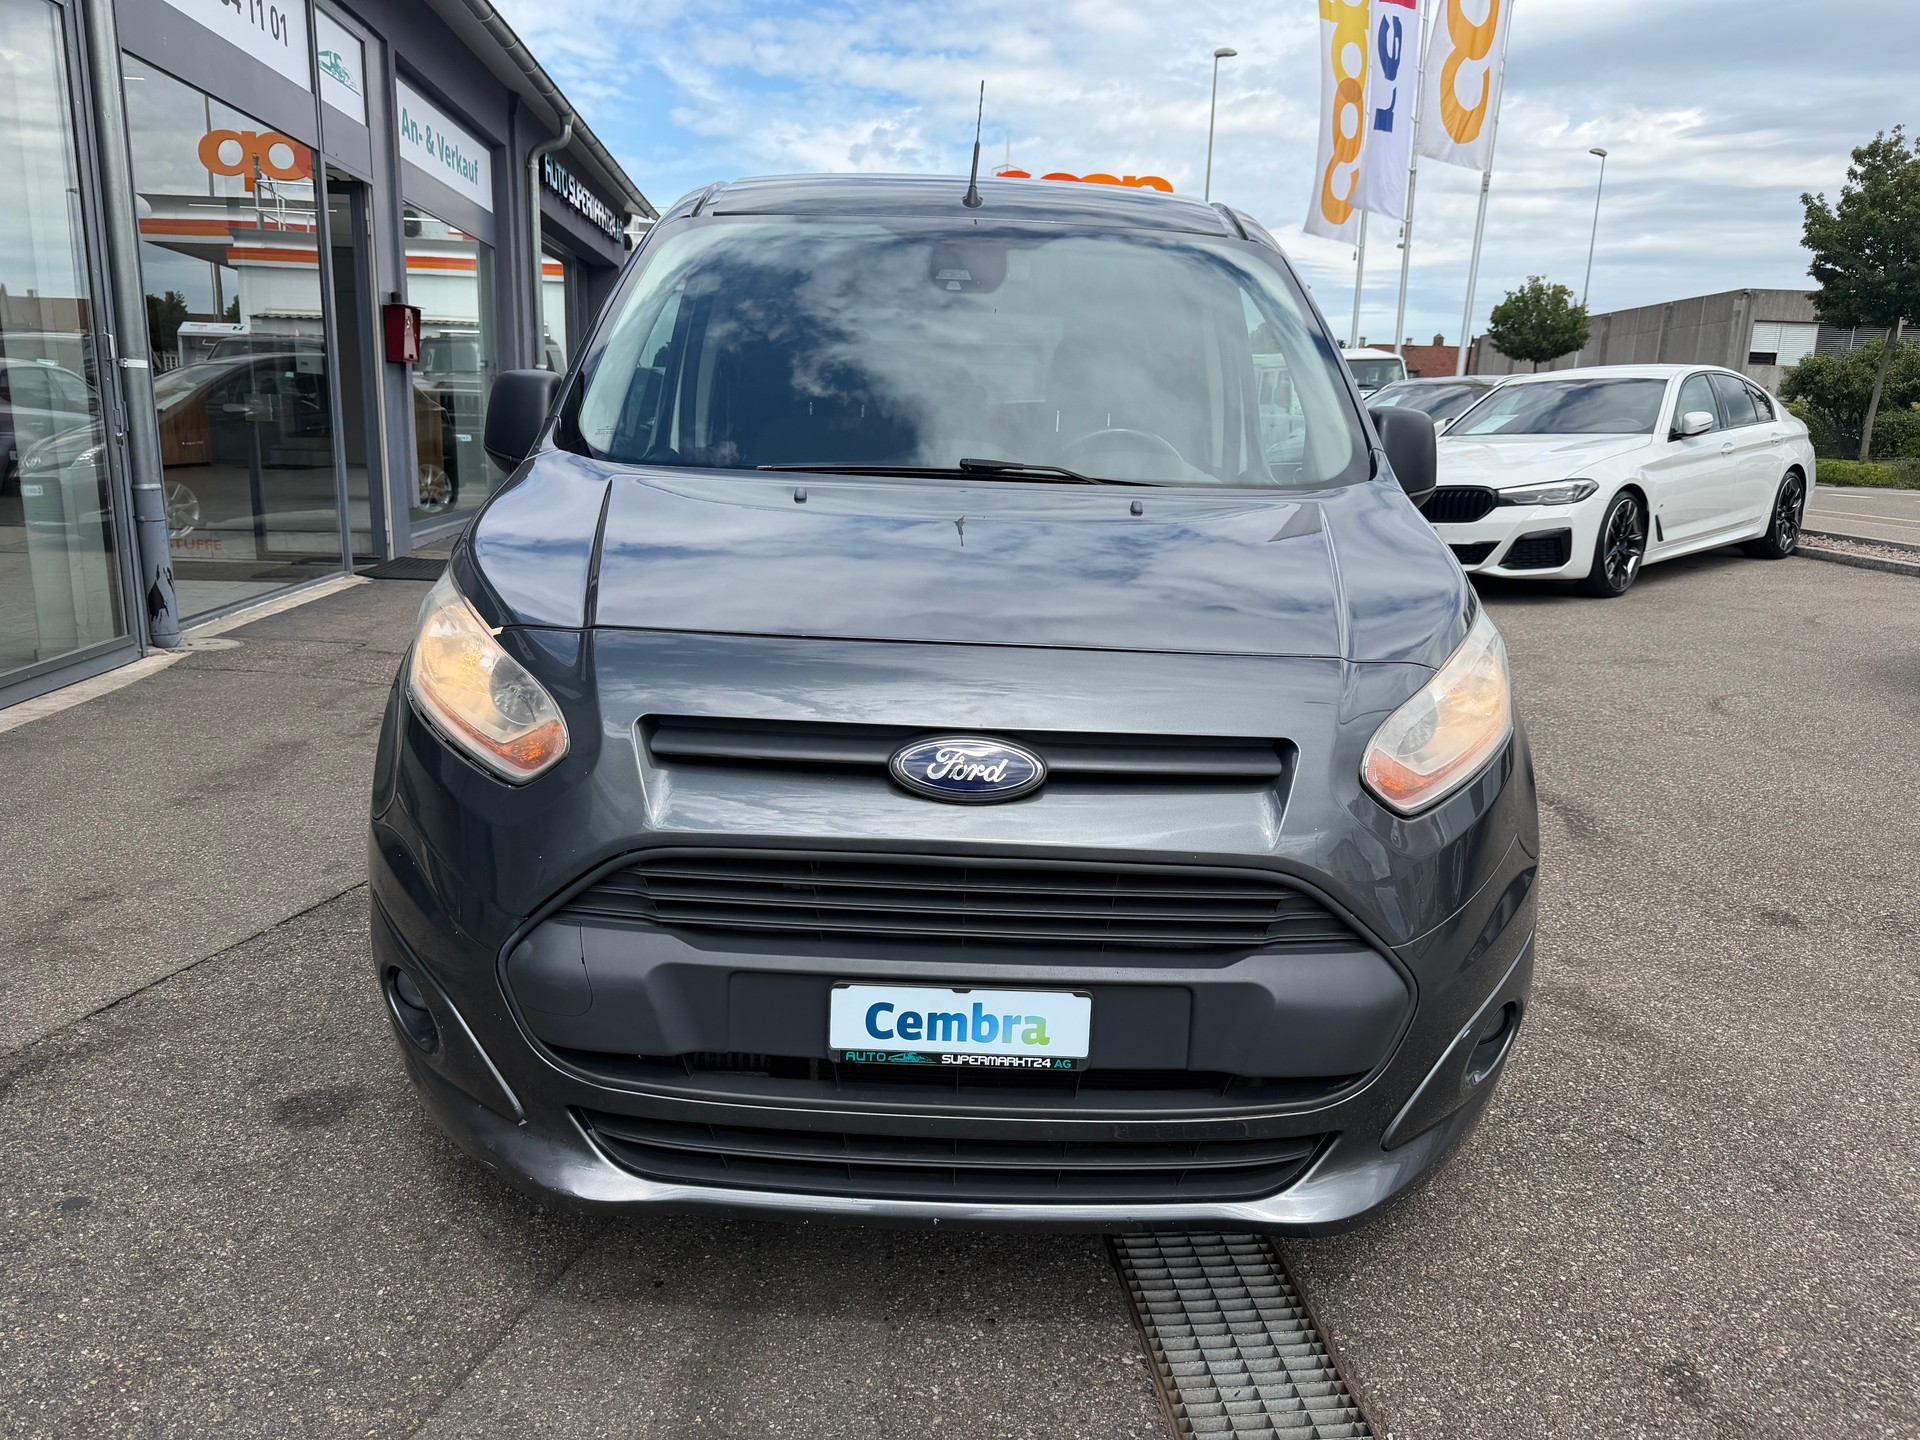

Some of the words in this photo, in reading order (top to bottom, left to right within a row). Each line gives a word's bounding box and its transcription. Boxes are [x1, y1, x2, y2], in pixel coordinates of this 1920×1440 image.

[270, 5, 288, 47] 01
[401, 107, 423, 146] An-
[425, 124, 435, 157] &
[436, 132, 479, 186] Verkauf
[544, 151, 569, 199] AUTO
[926, 747, 1010, 783] Ford
[865, 1001, 1051, 1046] Cembra
[845, 1051, 887, 1062] AUTO
[941, 1054, 1051, 1069] SUPERMARKT24
[1053, 1059, 1072, 1069] AG
